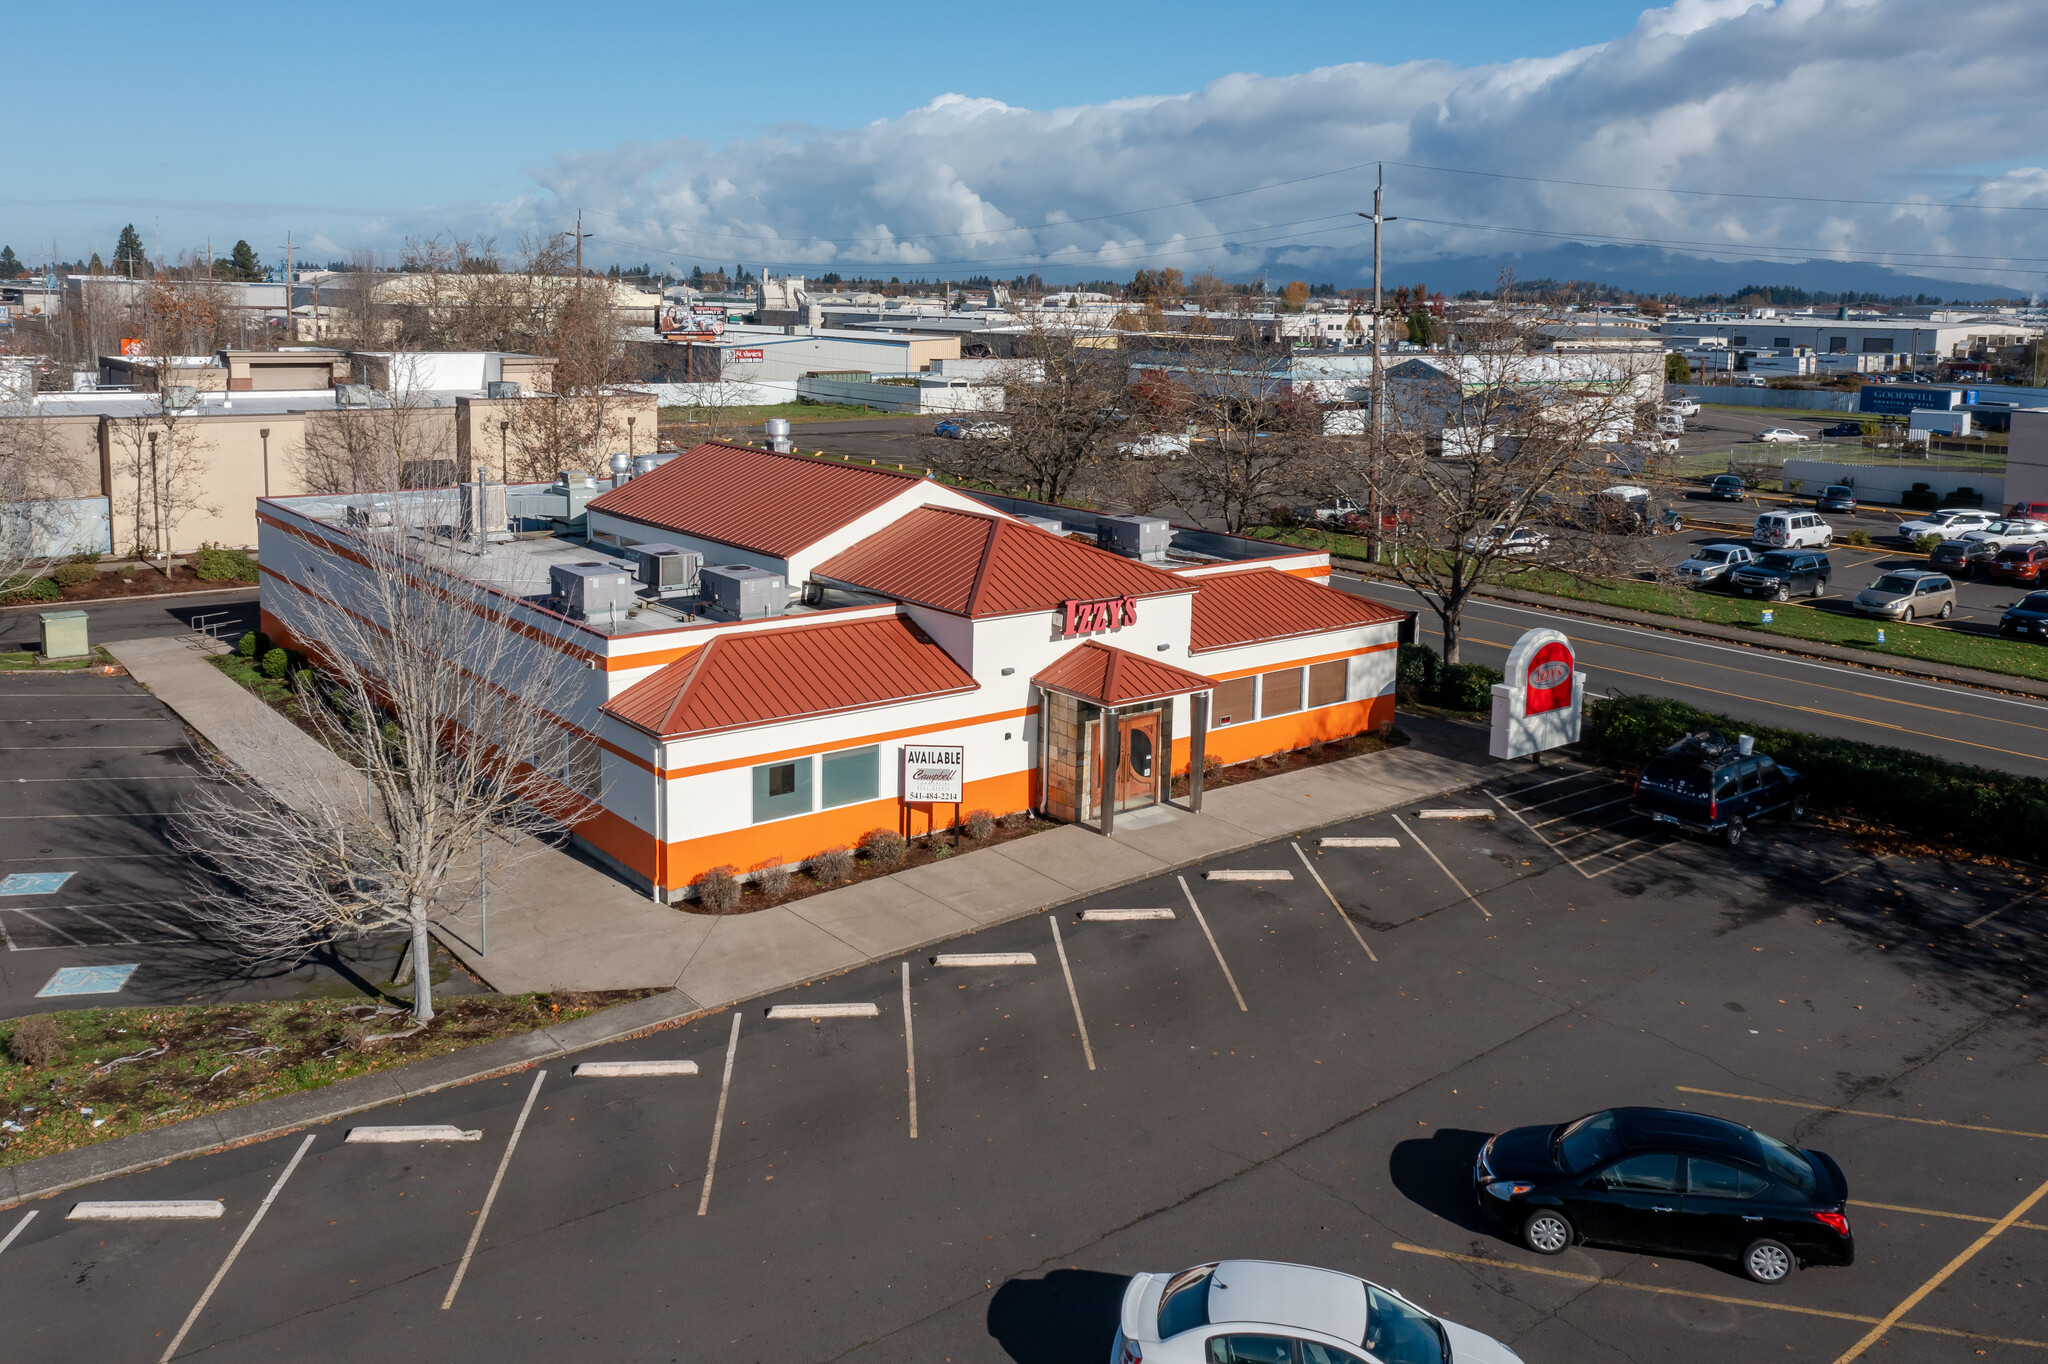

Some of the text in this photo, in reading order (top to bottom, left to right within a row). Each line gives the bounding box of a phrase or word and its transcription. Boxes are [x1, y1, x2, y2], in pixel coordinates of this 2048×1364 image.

[1874, 390, 1934, 401] GOODWILL
[1063, 596, 1137, 635] IZZY'S
[908, 751, 960, 764] AVAILABLE
[913, 769, 957, 783] Campbell
